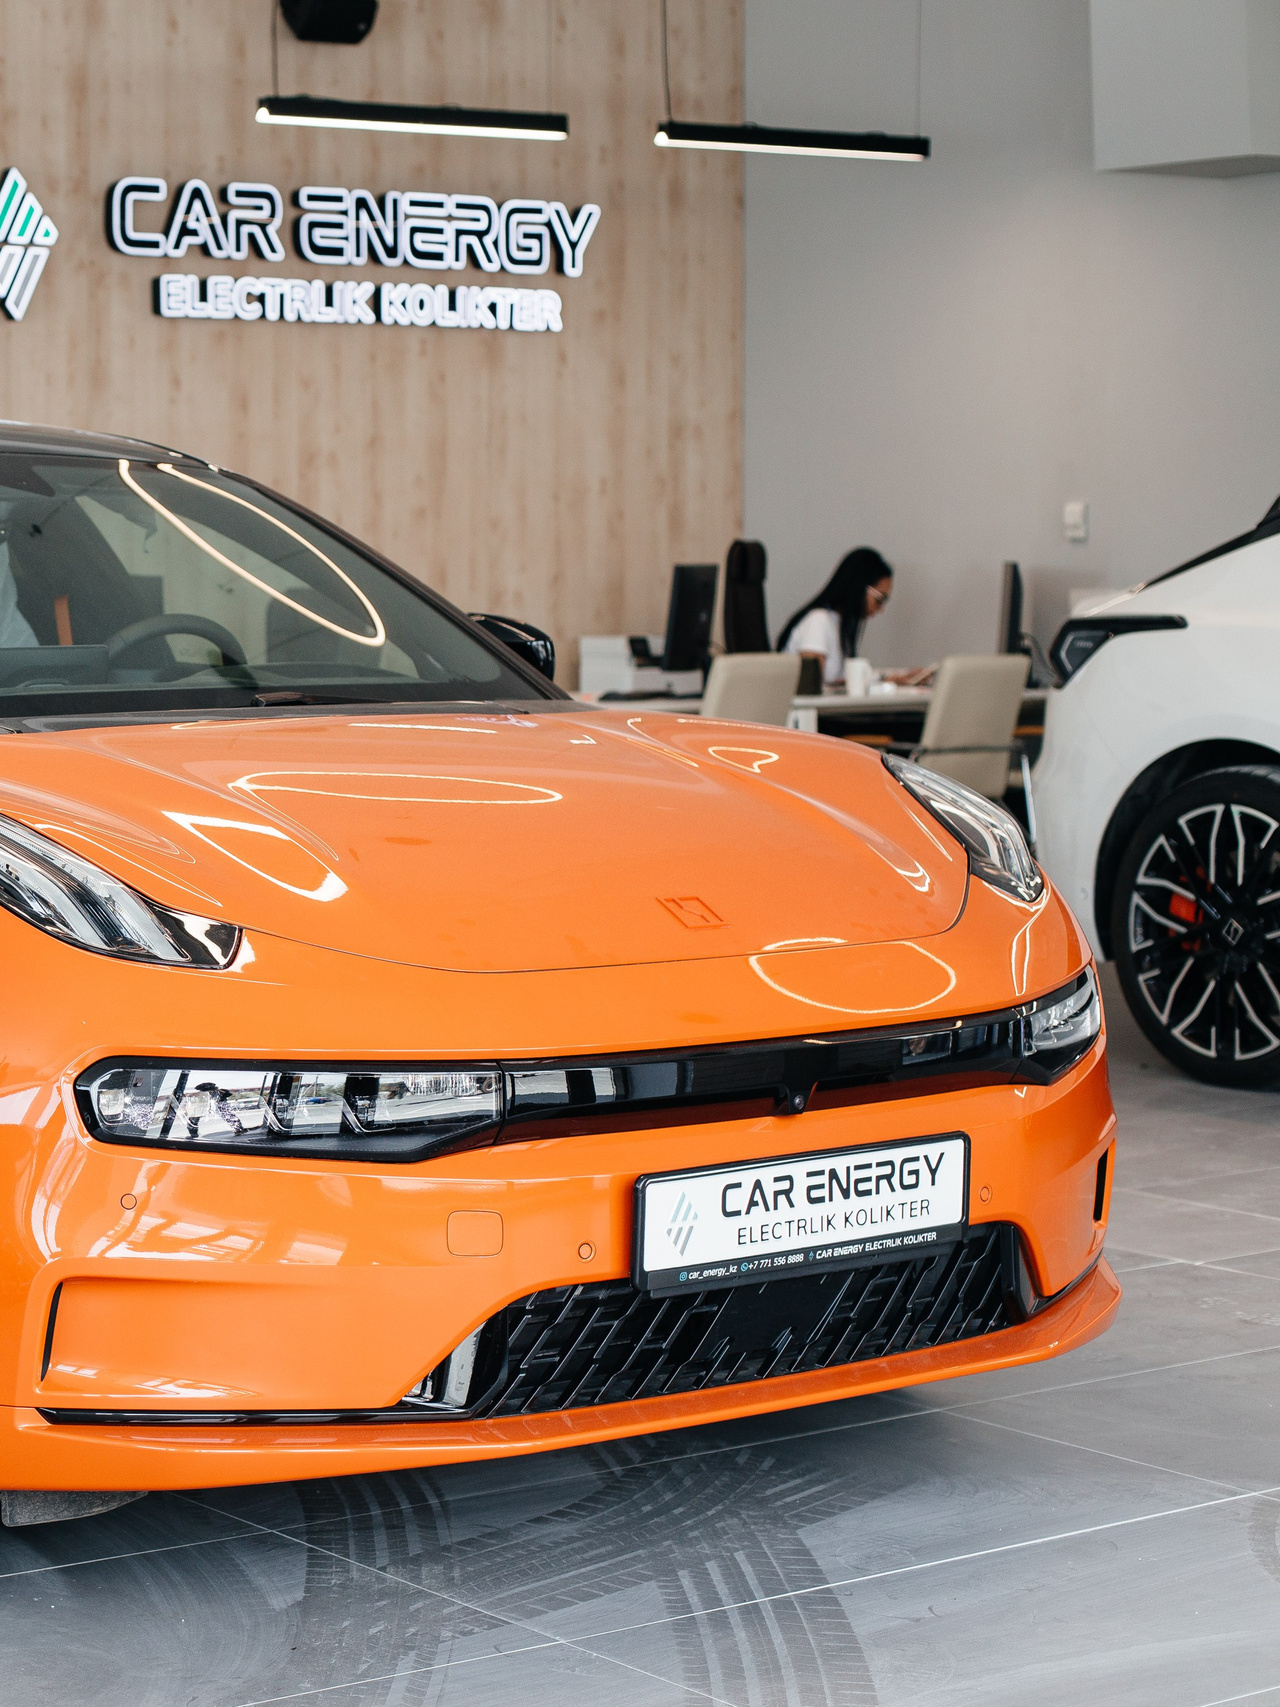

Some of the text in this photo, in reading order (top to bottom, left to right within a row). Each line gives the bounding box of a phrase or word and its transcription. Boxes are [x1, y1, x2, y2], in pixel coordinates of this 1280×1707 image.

[110, 176, 601, 278] CAR ENERGY
[158, 273, 563, 332] ELECTRLIK KOLIKTER
[721, 1152, 945, 1218] CAR ENERGY
[737, 1199, 930, 1246] ELECTRLIK KOLIKTER
[688, 1232, 937, 1280] car_energy_kz +7 771 556 8888 CAR ENERGY ELECTRLIK KOLIKTER
